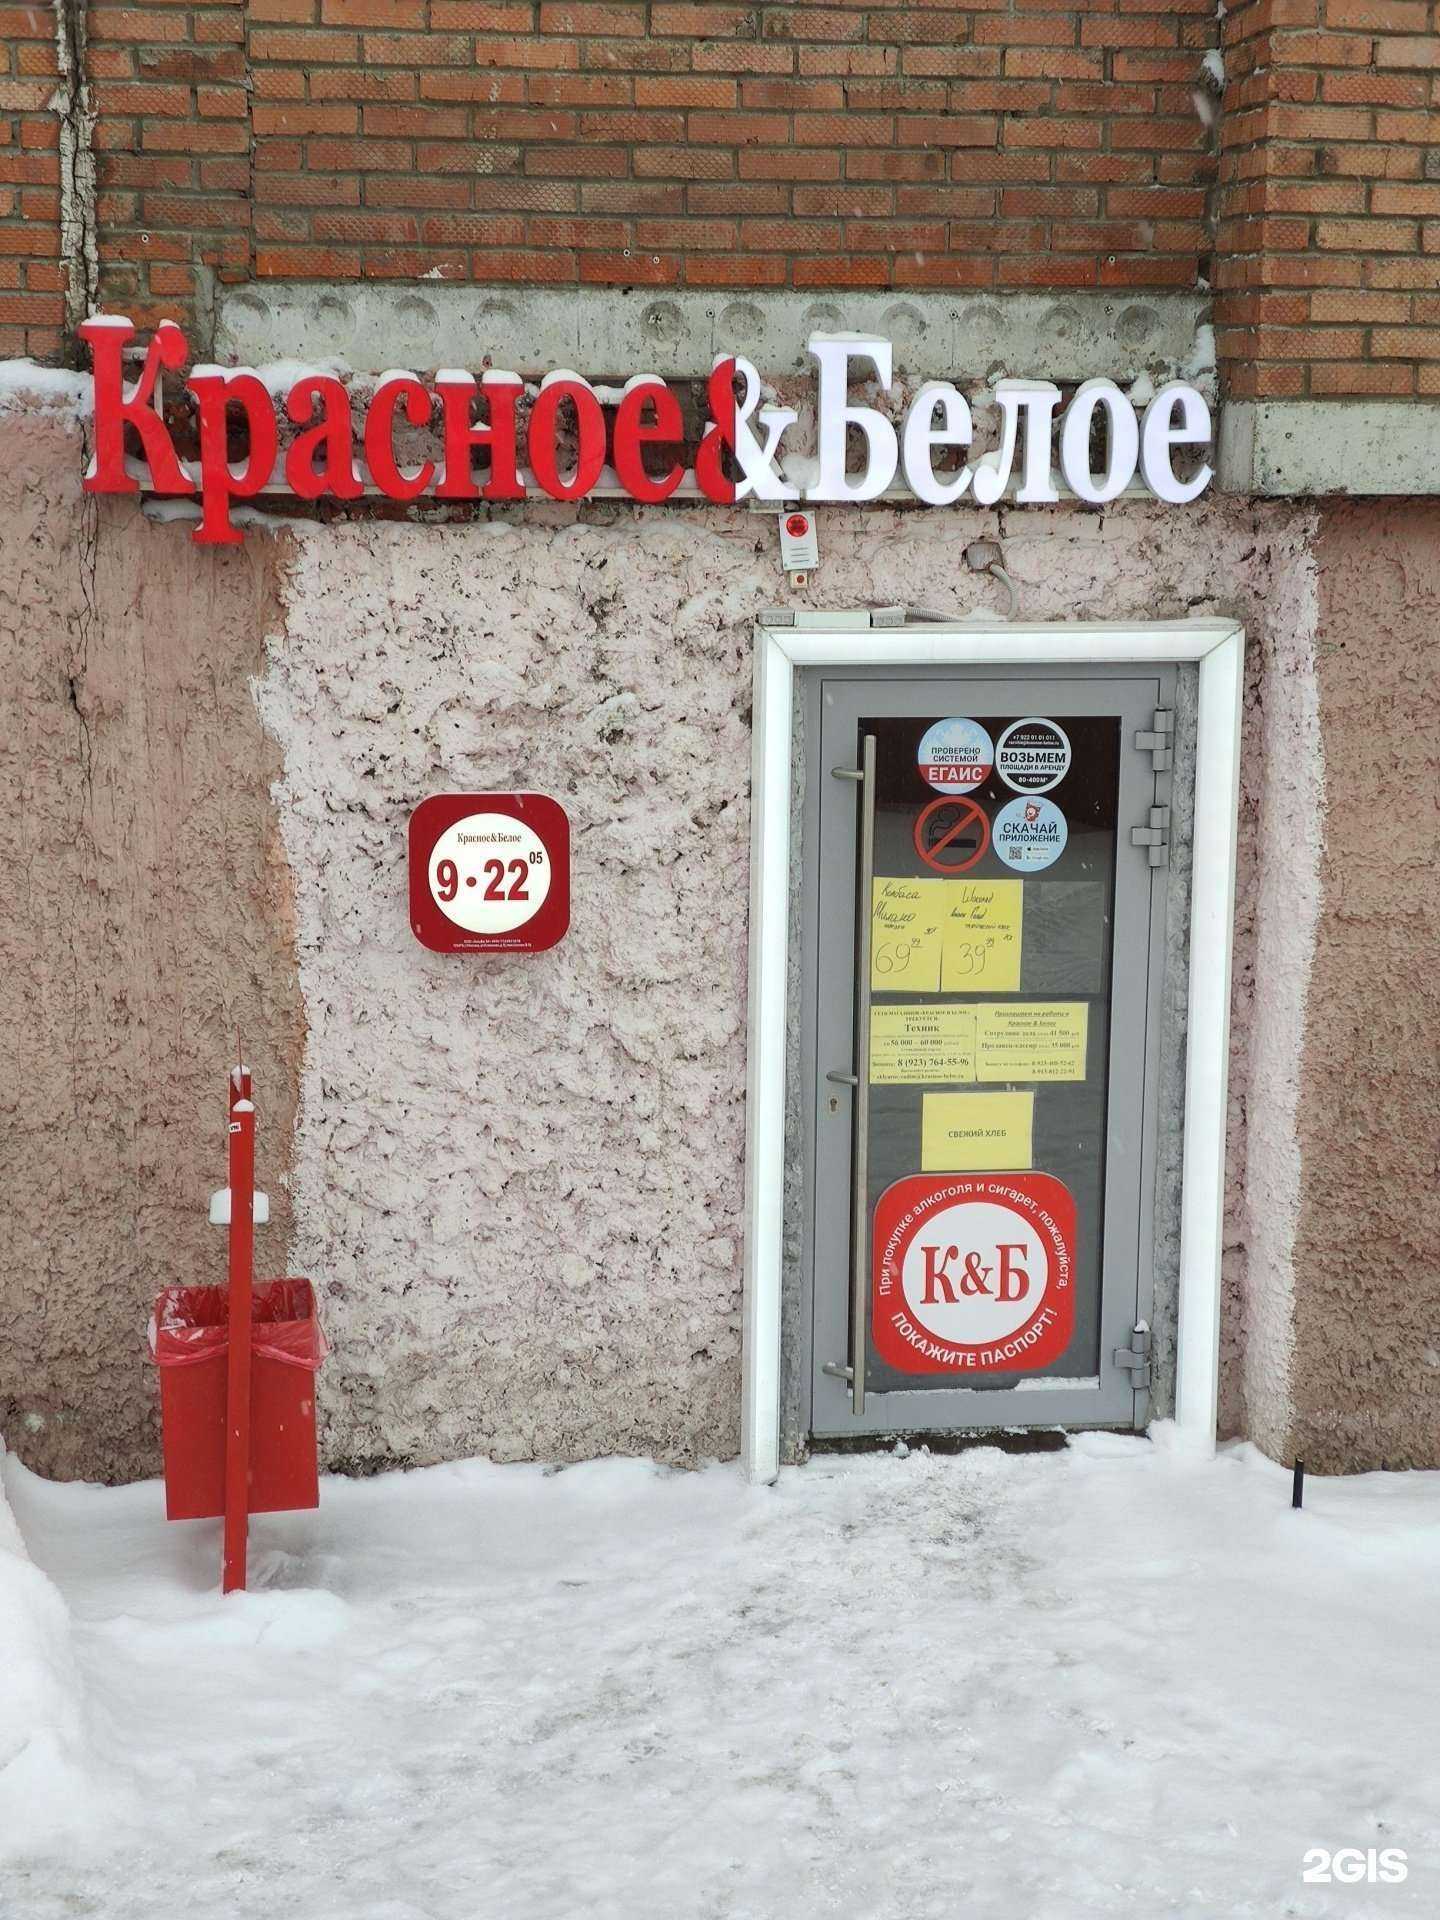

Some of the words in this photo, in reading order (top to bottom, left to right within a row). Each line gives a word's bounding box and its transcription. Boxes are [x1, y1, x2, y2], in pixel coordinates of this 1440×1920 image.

[931, 747, 981, 755] ПРОВЕРЕНО
[933, 754, 978, 762] СИСТЕМОЙ
[1000, 752, 1066, 763] ВОЗЬМЕМ
[928, 766, 983, 781] ЕГАИС
[1000, 764, 1033, 772] ПЛОЩАДИ
[1040, 764, 1065, 772] АРЕНДУ
[1003, 822, 1058, 834] СКАЧАЙ
[457, 832, 522, 845] Красное&Белое
[1000, 834, 1061, 843] ПРИЛОЖЕНИЕ
[905, 1023, 940, 1032] Техник
[897, 1058, 903, 1067] 8
[904, 1058, 927, 1067] (923)
[948, 1128, 983, 1138] СВЕЖИЙ
[985, 1128, 1007, 1137] ХЛЕБ
[976, 1183, 985, 1192] и
[913, 1183, 973, 1216] алкоголя
[988, 1183, 1038, 1215] сигарет,
[883, 1214, 914, 1267] покупке
[1038, 1211, 1072, 1290] пожалуйста,
[920, 1243, 1030, 1304] К&Б
[879, 1268, 894, 1296] При
[891, 1311, 976, 1366] ПОКАЖИТЕ
[980, 1307, 1058, 1365] ПАСПОРТ!
